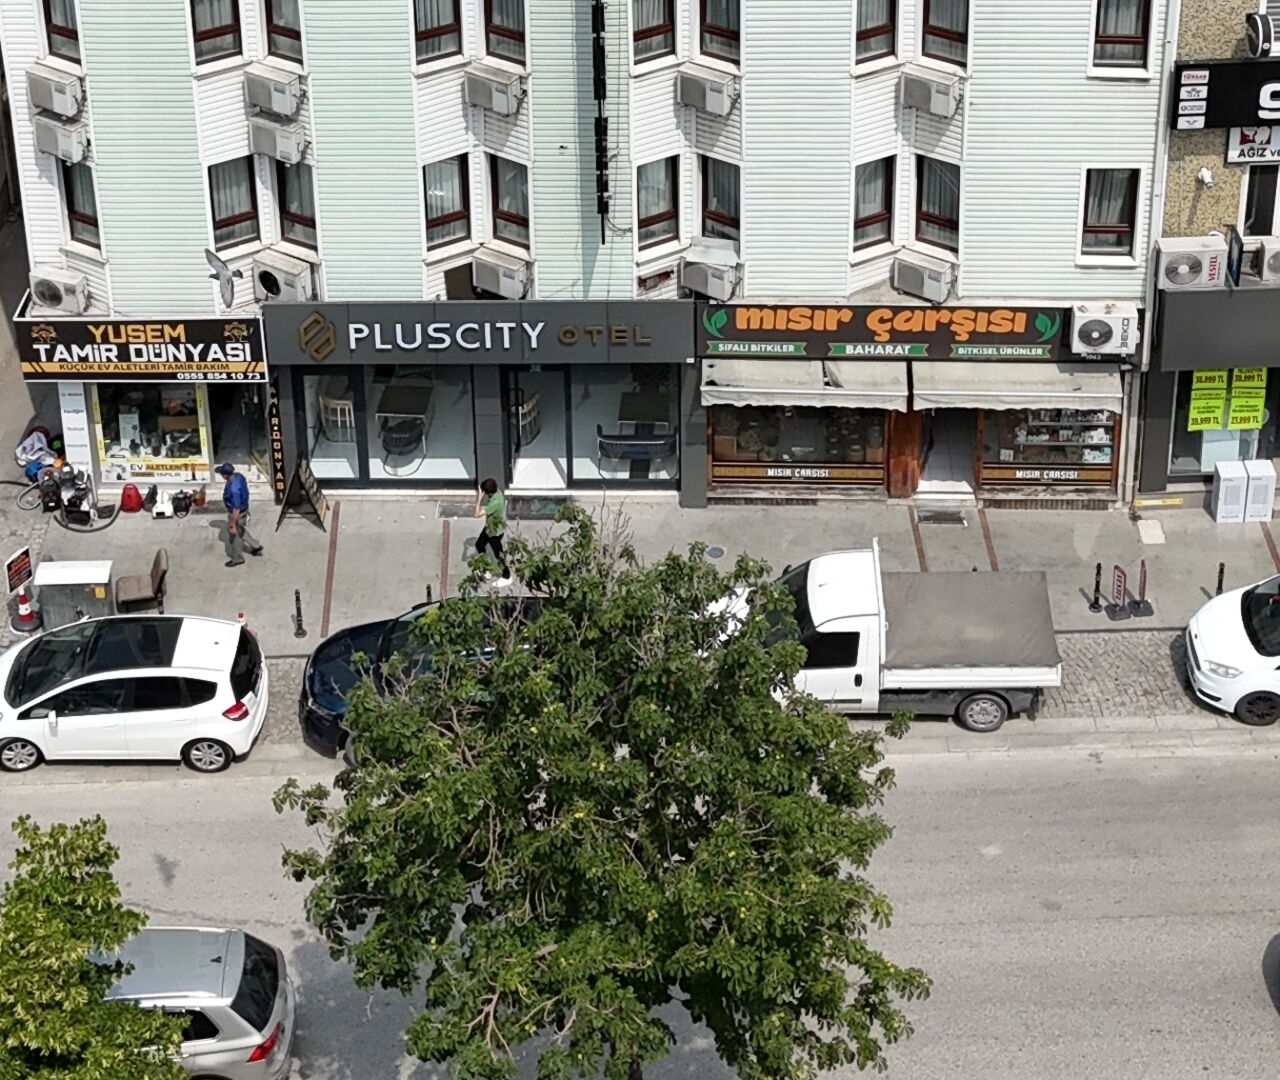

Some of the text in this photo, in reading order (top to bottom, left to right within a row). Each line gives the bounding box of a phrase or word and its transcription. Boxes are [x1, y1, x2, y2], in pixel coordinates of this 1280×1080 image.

[1238, 145, 1267, 158] AĞIZ
[1208, 255, 1218, 281] VESTEL
[88, 324, 186, 343] YUSEM
[348, 322, 653, 350] PLUSCITY OTEL
[129, 342, 252, 362] DÜNYASI
[750, 343, 795, 353] BİTKİLER
[846, 344, 911, 355] BAHARAT
[958, 345, 1043, 356] BİTKİSEL ÜRÜNLER
[59, 362, 230, 373] KÜÇÜK EV ALETLERİ TAMİR BAKIM
[230, 372, 243, 380] 10
[246, 372, 260, 380] 73
[768, 468, 792, 477] MISIR
[1015, 470, 1040, 478] MISIR
